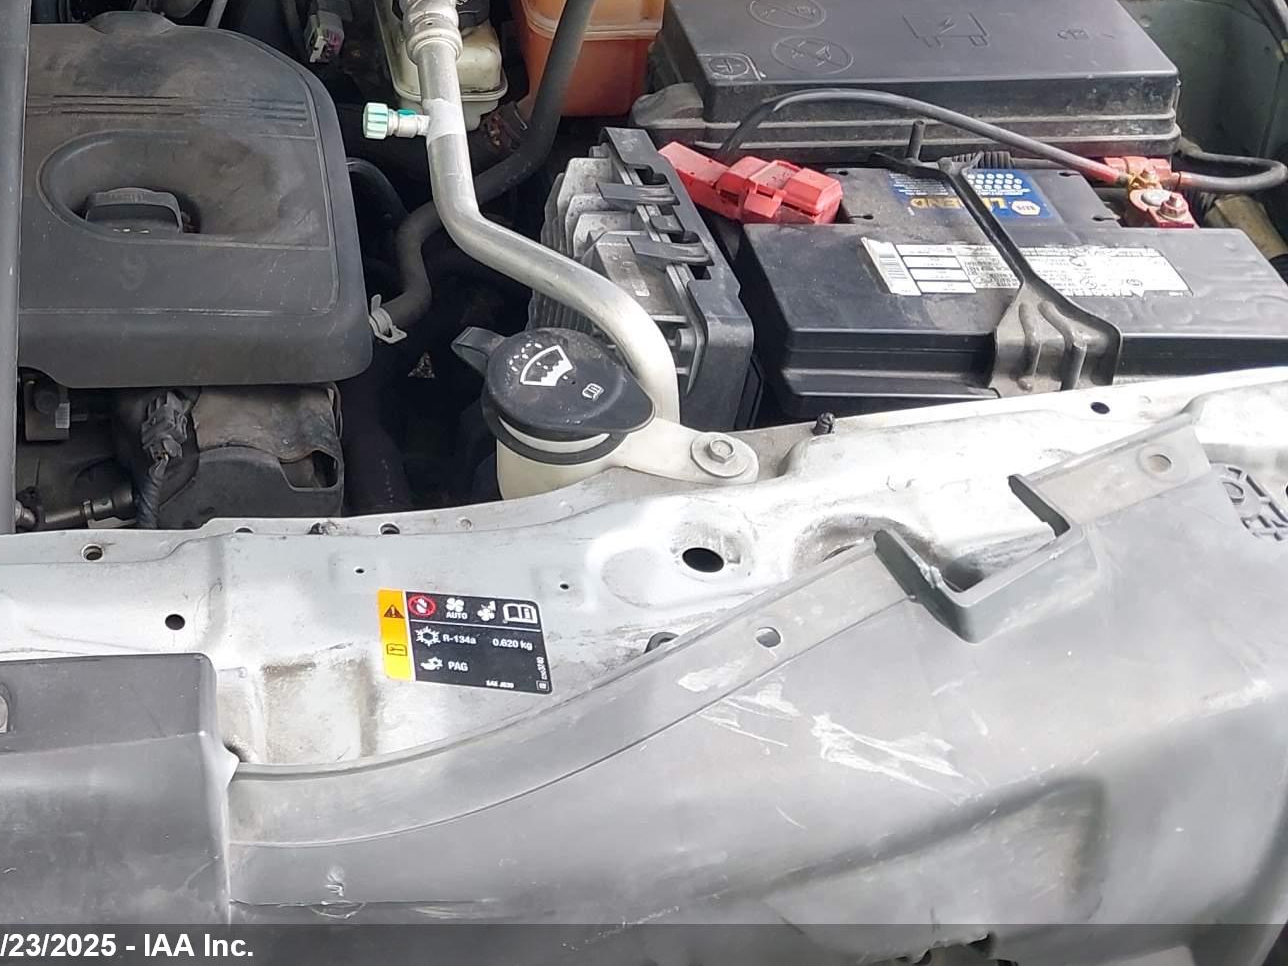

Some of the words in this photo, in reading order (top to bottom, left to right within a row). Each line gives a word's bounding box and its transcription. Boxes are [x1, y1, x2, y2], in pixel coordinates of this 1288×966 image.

[910, 197, 1008, 210] LEND
[446, 611, 468, 620] AUTO
[443, 634, 477, 645] R-134a
[492, 638, 519, 649] 0.620
[520, 640, 533, 651] kg
[448, 661, 469, 672] PAG
